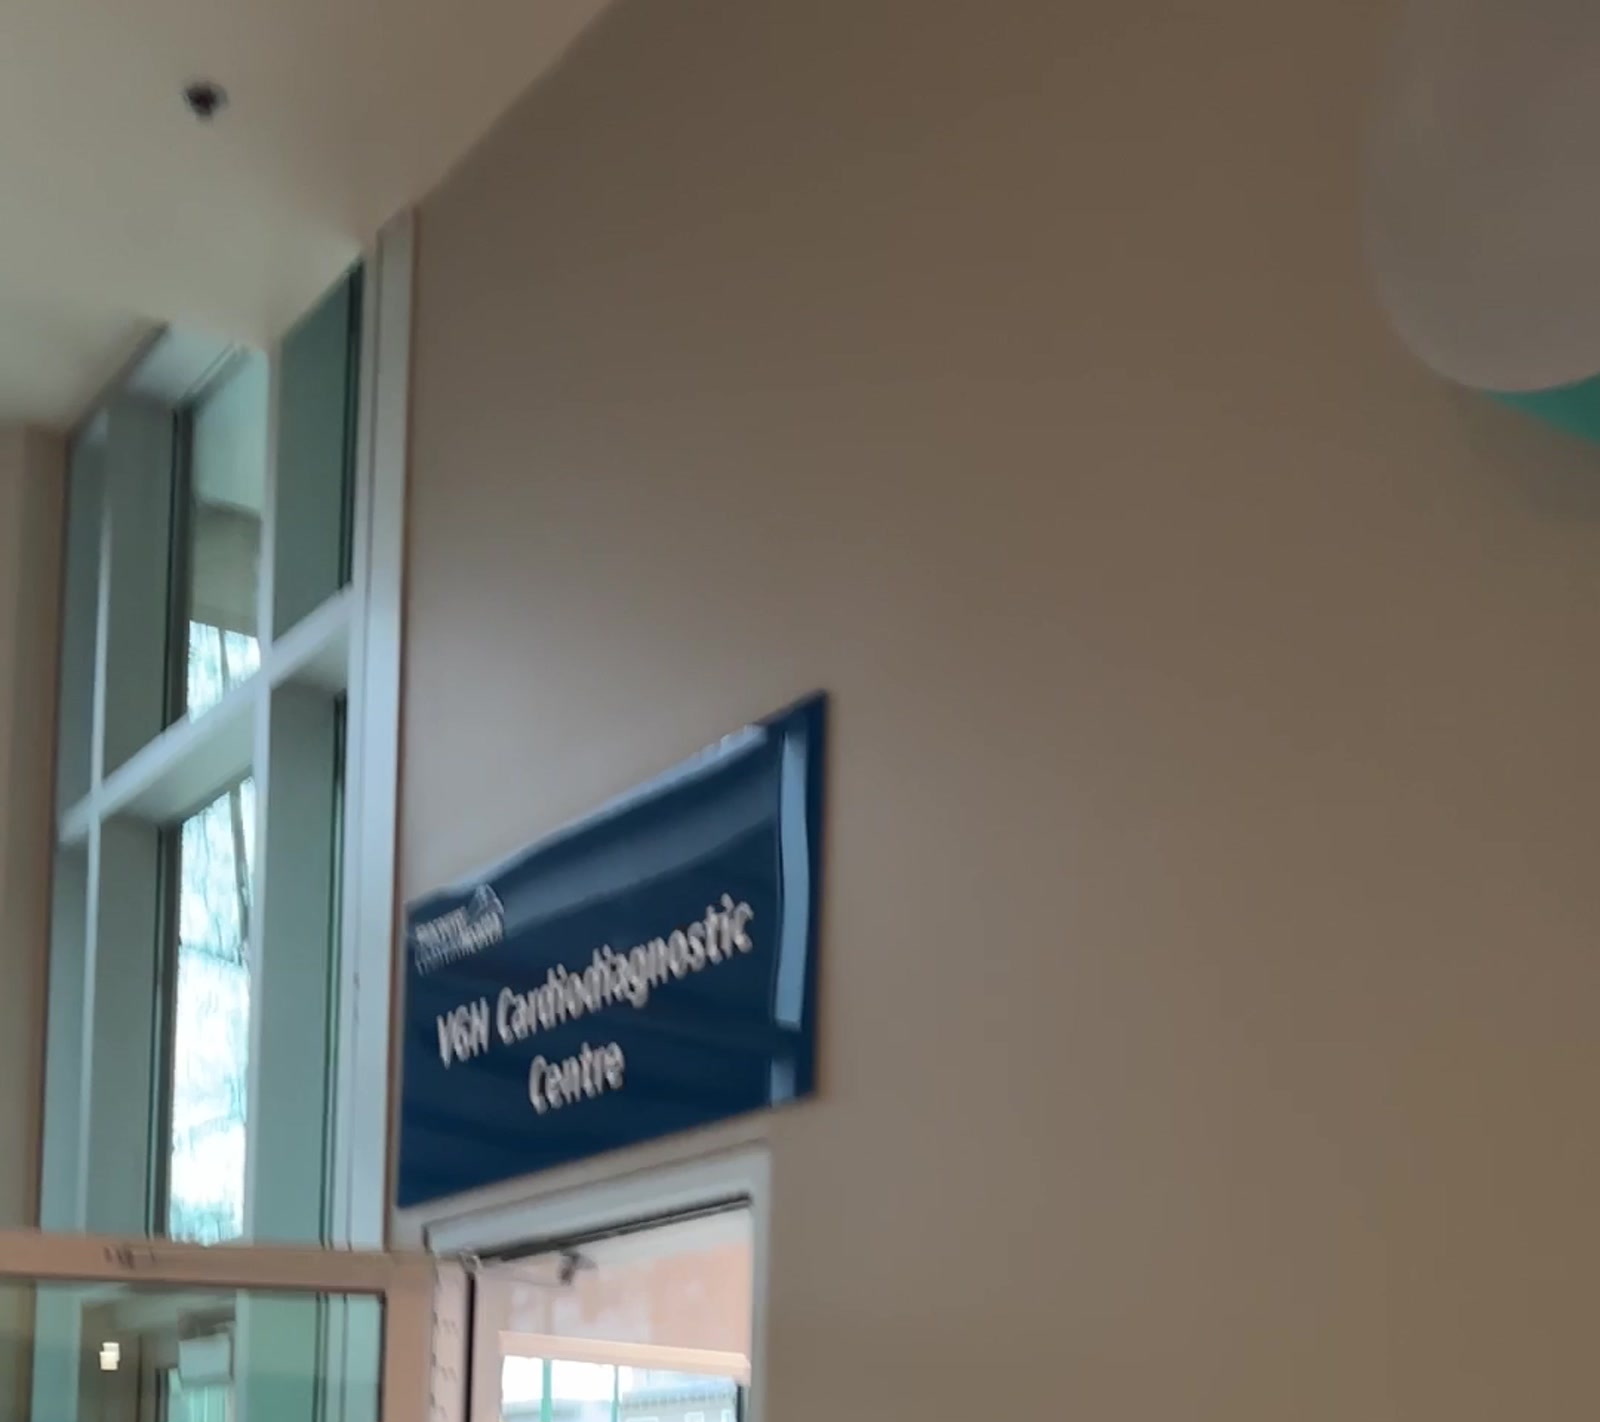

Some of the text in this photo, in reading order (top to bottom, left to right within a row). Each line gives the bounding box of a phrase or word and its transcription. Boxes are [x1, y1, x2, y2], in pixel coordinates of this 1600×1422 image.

[438, 998, 489, 1067] VGH
[497, 893, 754, 1044] Cardiodiagnostic
[530, 1042, 624, 1114] Centre
